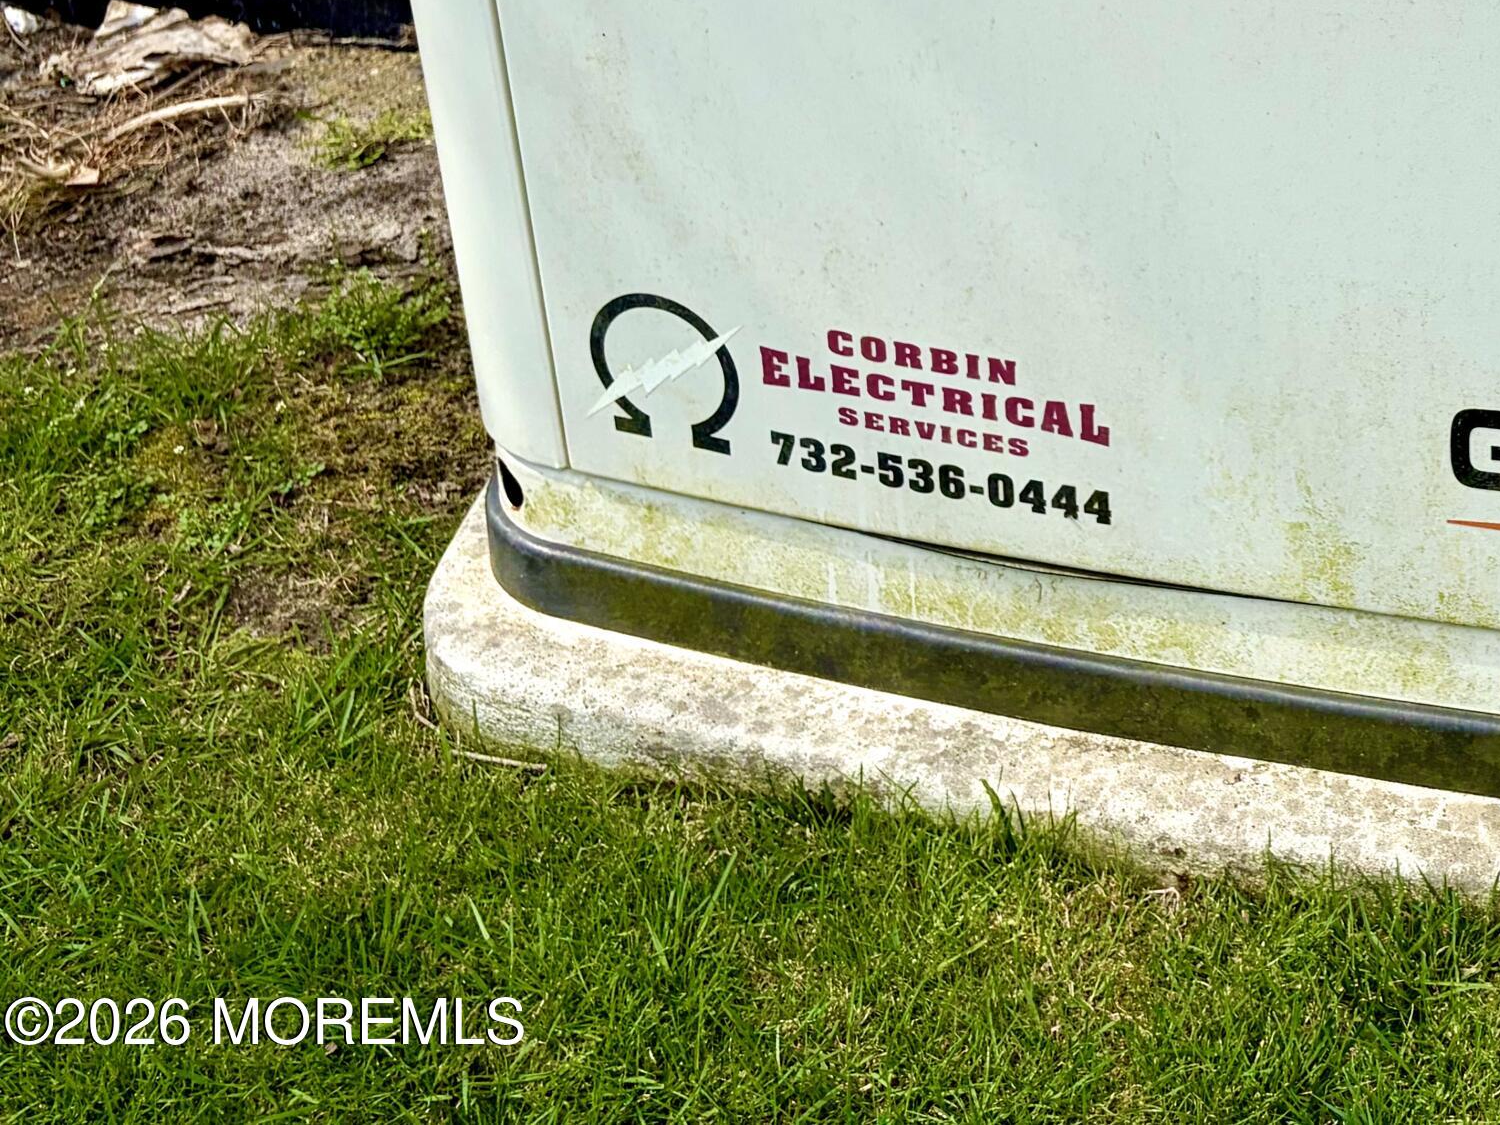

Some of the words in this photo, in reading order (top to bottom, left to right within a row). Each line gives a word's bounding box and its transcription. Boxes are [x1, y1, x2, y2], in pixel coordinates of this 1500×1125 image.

[827, 329, 1017, 385] CORBIN
[759, 345, 1110, 446] ELECTRICAL
[839, 407, 1029, 457] SERVICES
[770, 431, 1112, 524] 732-536-0444
